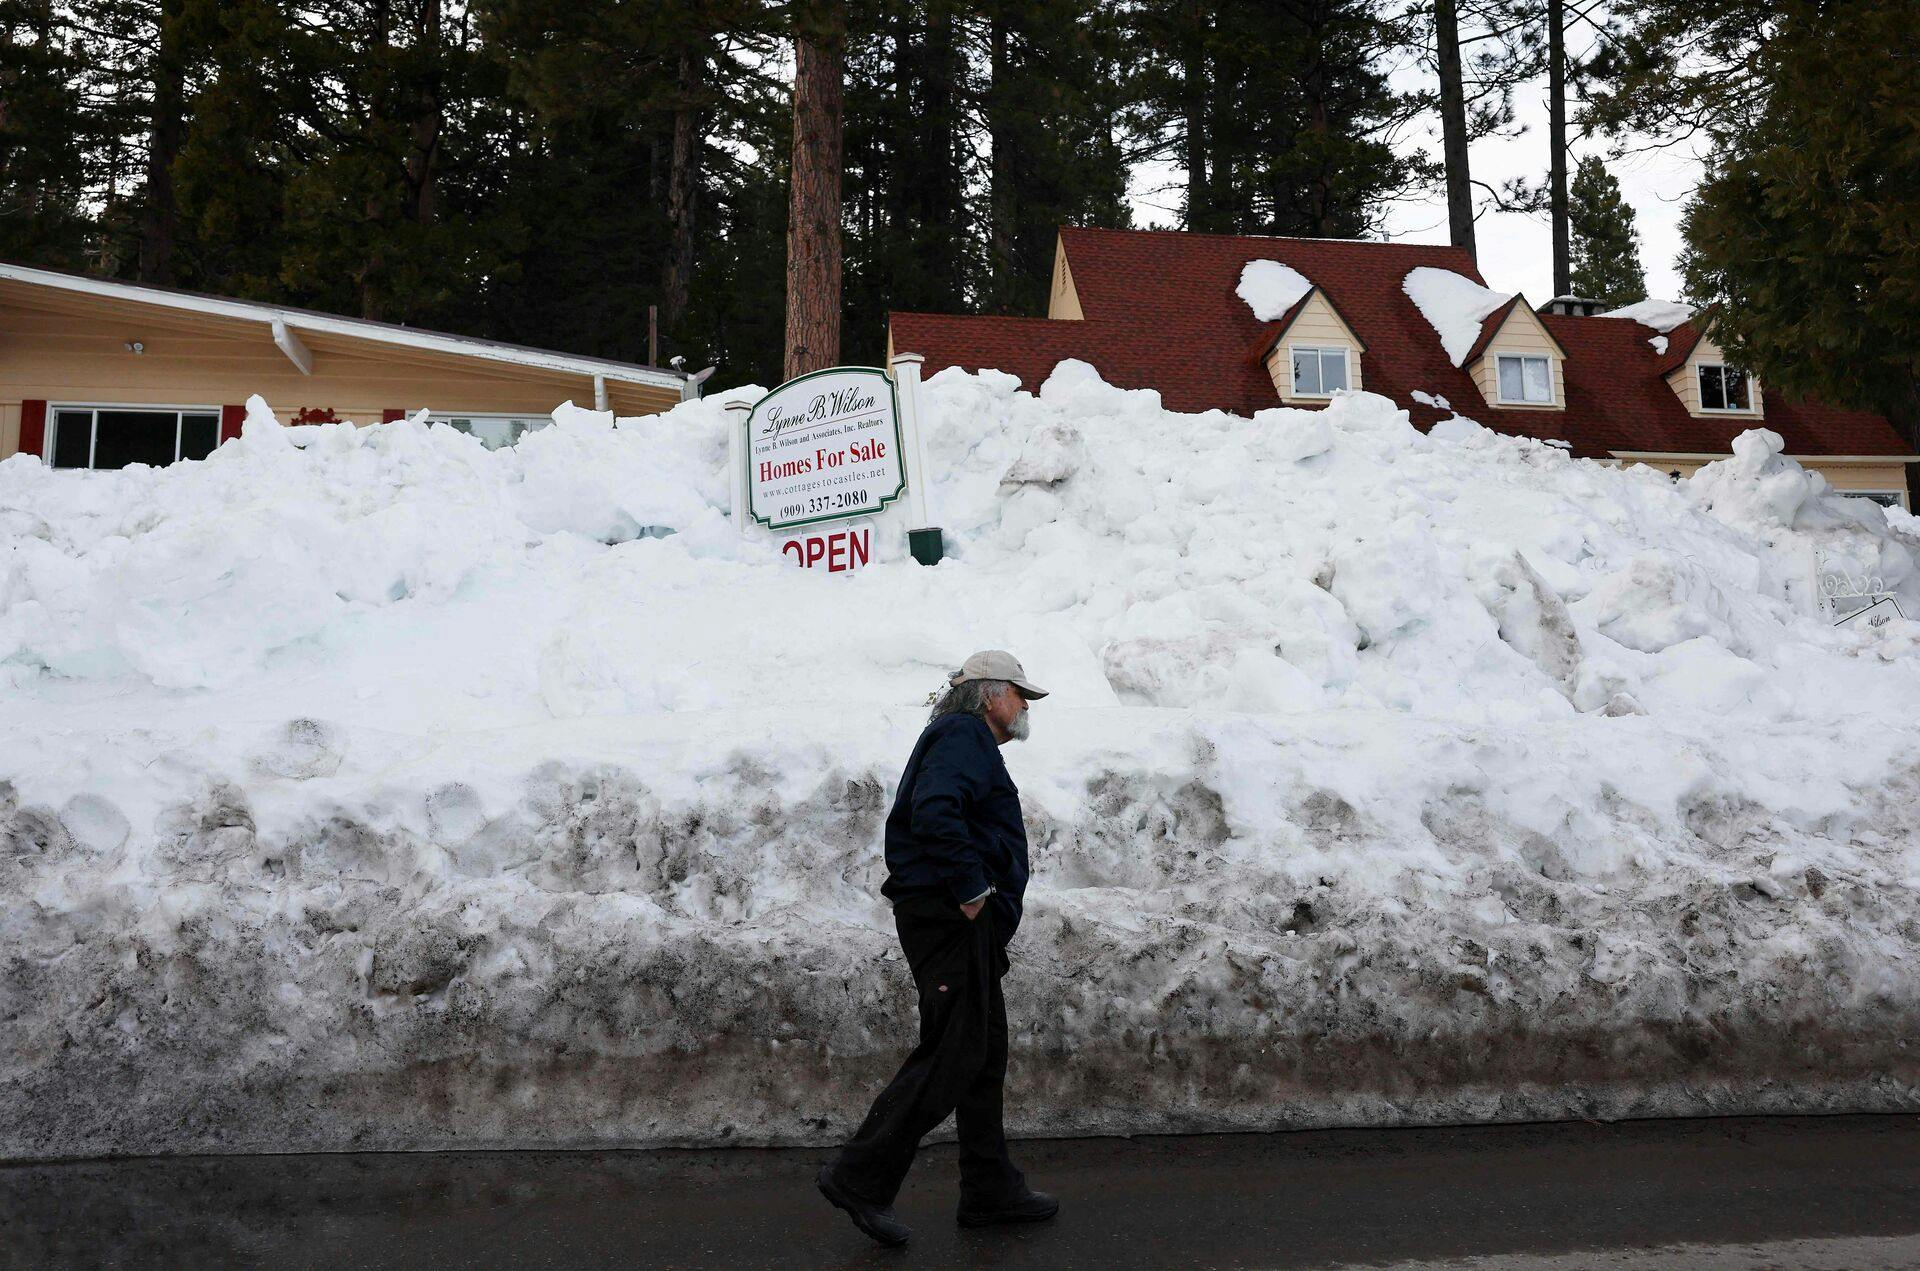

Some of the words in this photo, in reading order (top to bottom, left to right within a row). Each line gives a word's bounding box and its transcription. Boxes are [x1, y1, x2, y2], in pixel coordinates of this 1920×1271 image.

[762, 406, 806, 441] Lynne
[807, 394, 827, 422] B.
[828, 386, 875, 417] Wilson
[755, 445, 771, 455] Lynne
[779, 438, 798, 447] Wilson
[799, 433, 810, 444] and
[811, 428, 843, 440] Associates,
[844, 424, 856, 433] Inc.
[857, 418, 884, 430] Realtors
[759, 457, 812, 482] Homes
[815, 448, 845, 471] For
[849, 437, 886, 463] Sale
[780, 503, 805, 519] (909)
[808, 488, 868, 513] 337-2080
[782, 528, 869, 573] OPEN
